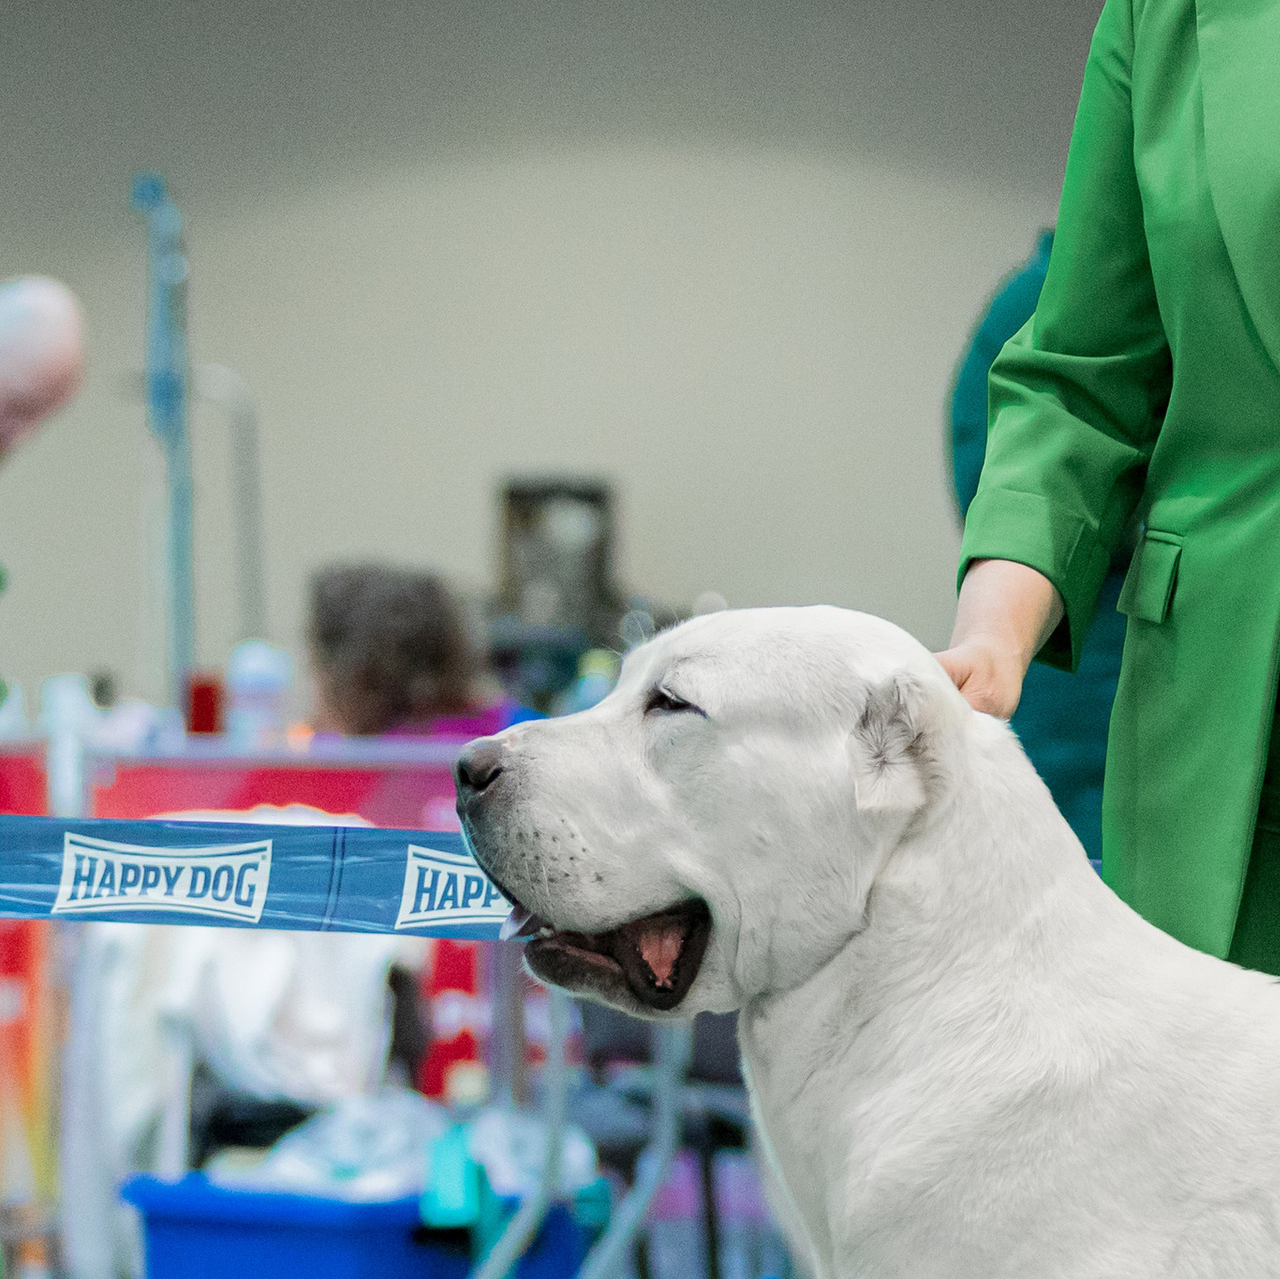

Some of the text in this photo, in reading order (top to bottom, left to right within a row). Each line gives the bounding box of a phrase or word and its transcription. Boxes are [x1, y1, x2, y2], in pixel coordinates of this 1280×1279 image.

[67, 853, 260, 908] HAPPY DOG
[409, 865, 514, 914] HAPP
